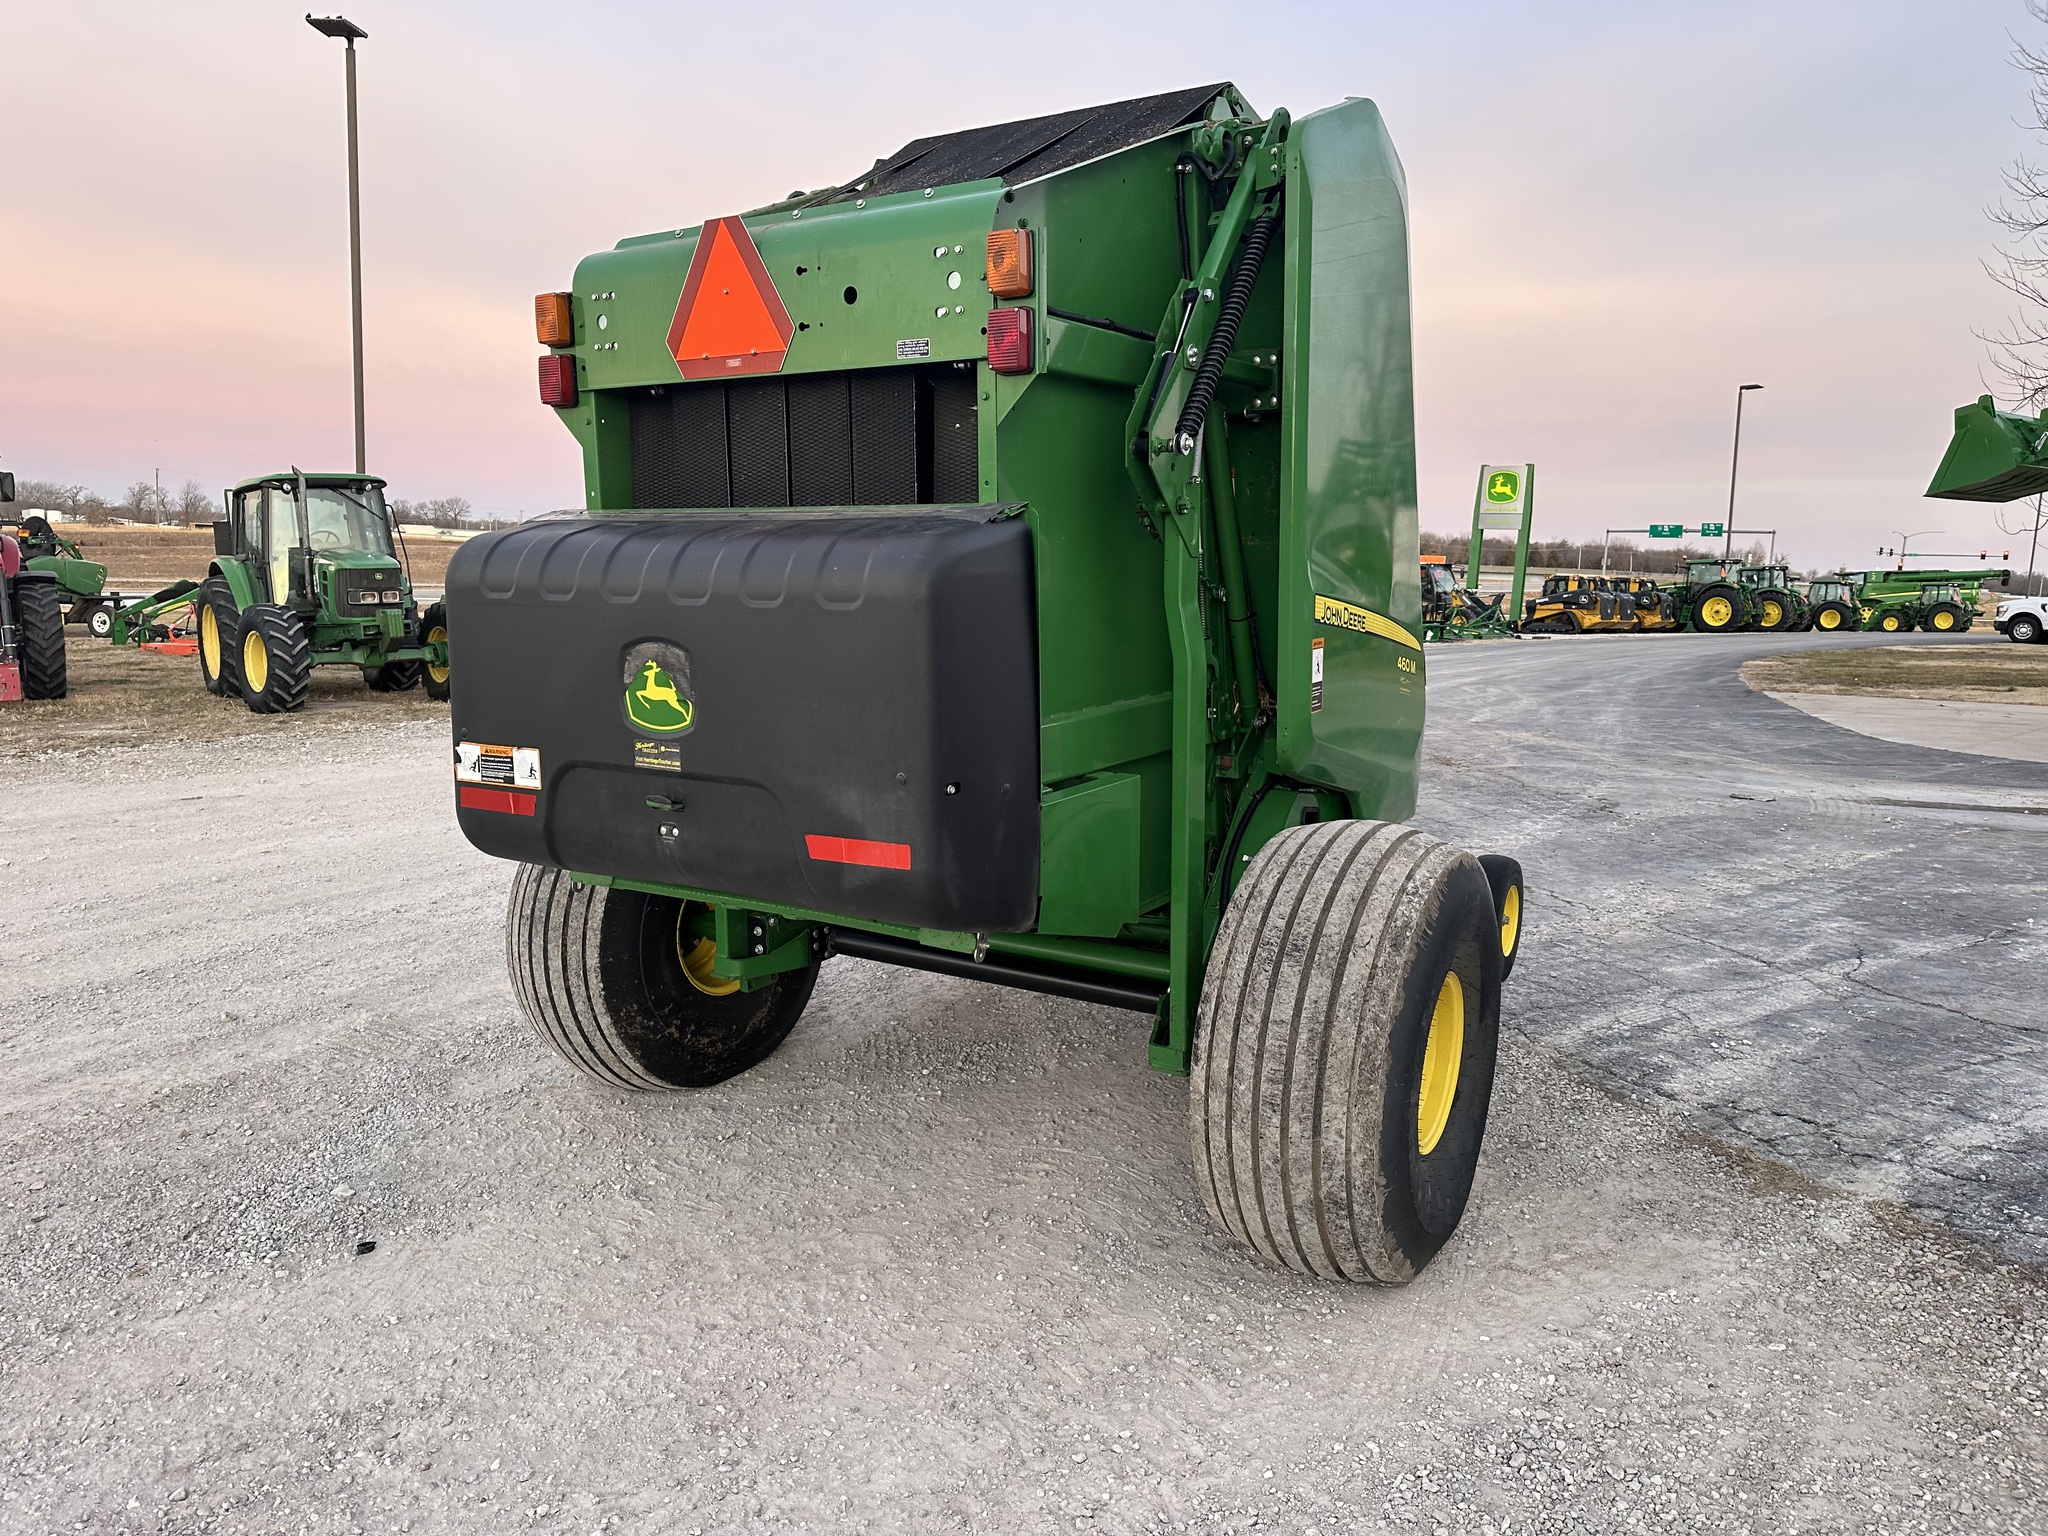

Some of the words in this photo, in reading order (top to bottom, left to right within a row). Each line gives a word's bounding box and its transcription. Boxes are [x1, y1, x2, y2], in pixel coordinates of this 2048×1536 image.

[1321, 602, 1342, 624] JOHN
[1342, 607, 1366, 630] DEERE
[1397, 656, 1410, 672] 460
[1410, 660, 1416, 674] M
